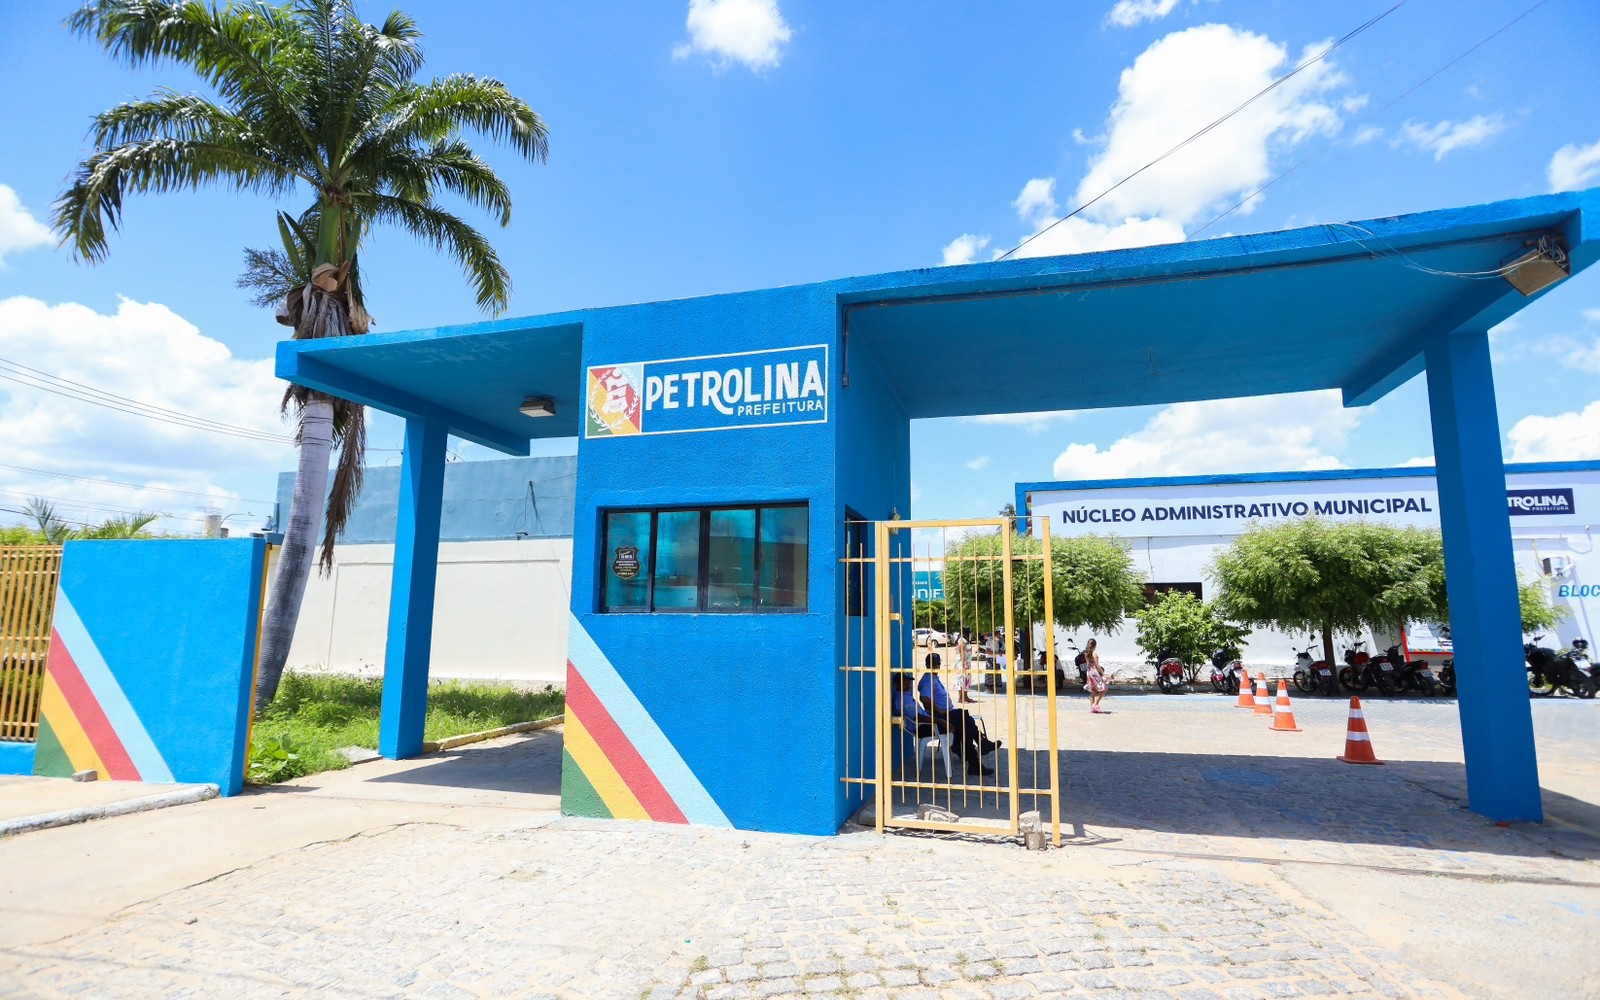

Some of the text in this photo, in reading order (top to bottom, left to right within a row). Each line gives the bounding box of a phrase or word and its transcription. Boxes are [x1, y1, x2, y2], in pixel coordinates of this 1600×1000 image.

[645, 360, 825, 415] PETROLINA
[737, 400, 824, 416] PREFEITURA
[1062, 497, 1432, 524] NÚCLEO ADMINISTRATIVO MUNICIPAL
[1558, 584, 1600, 597] BLOC
